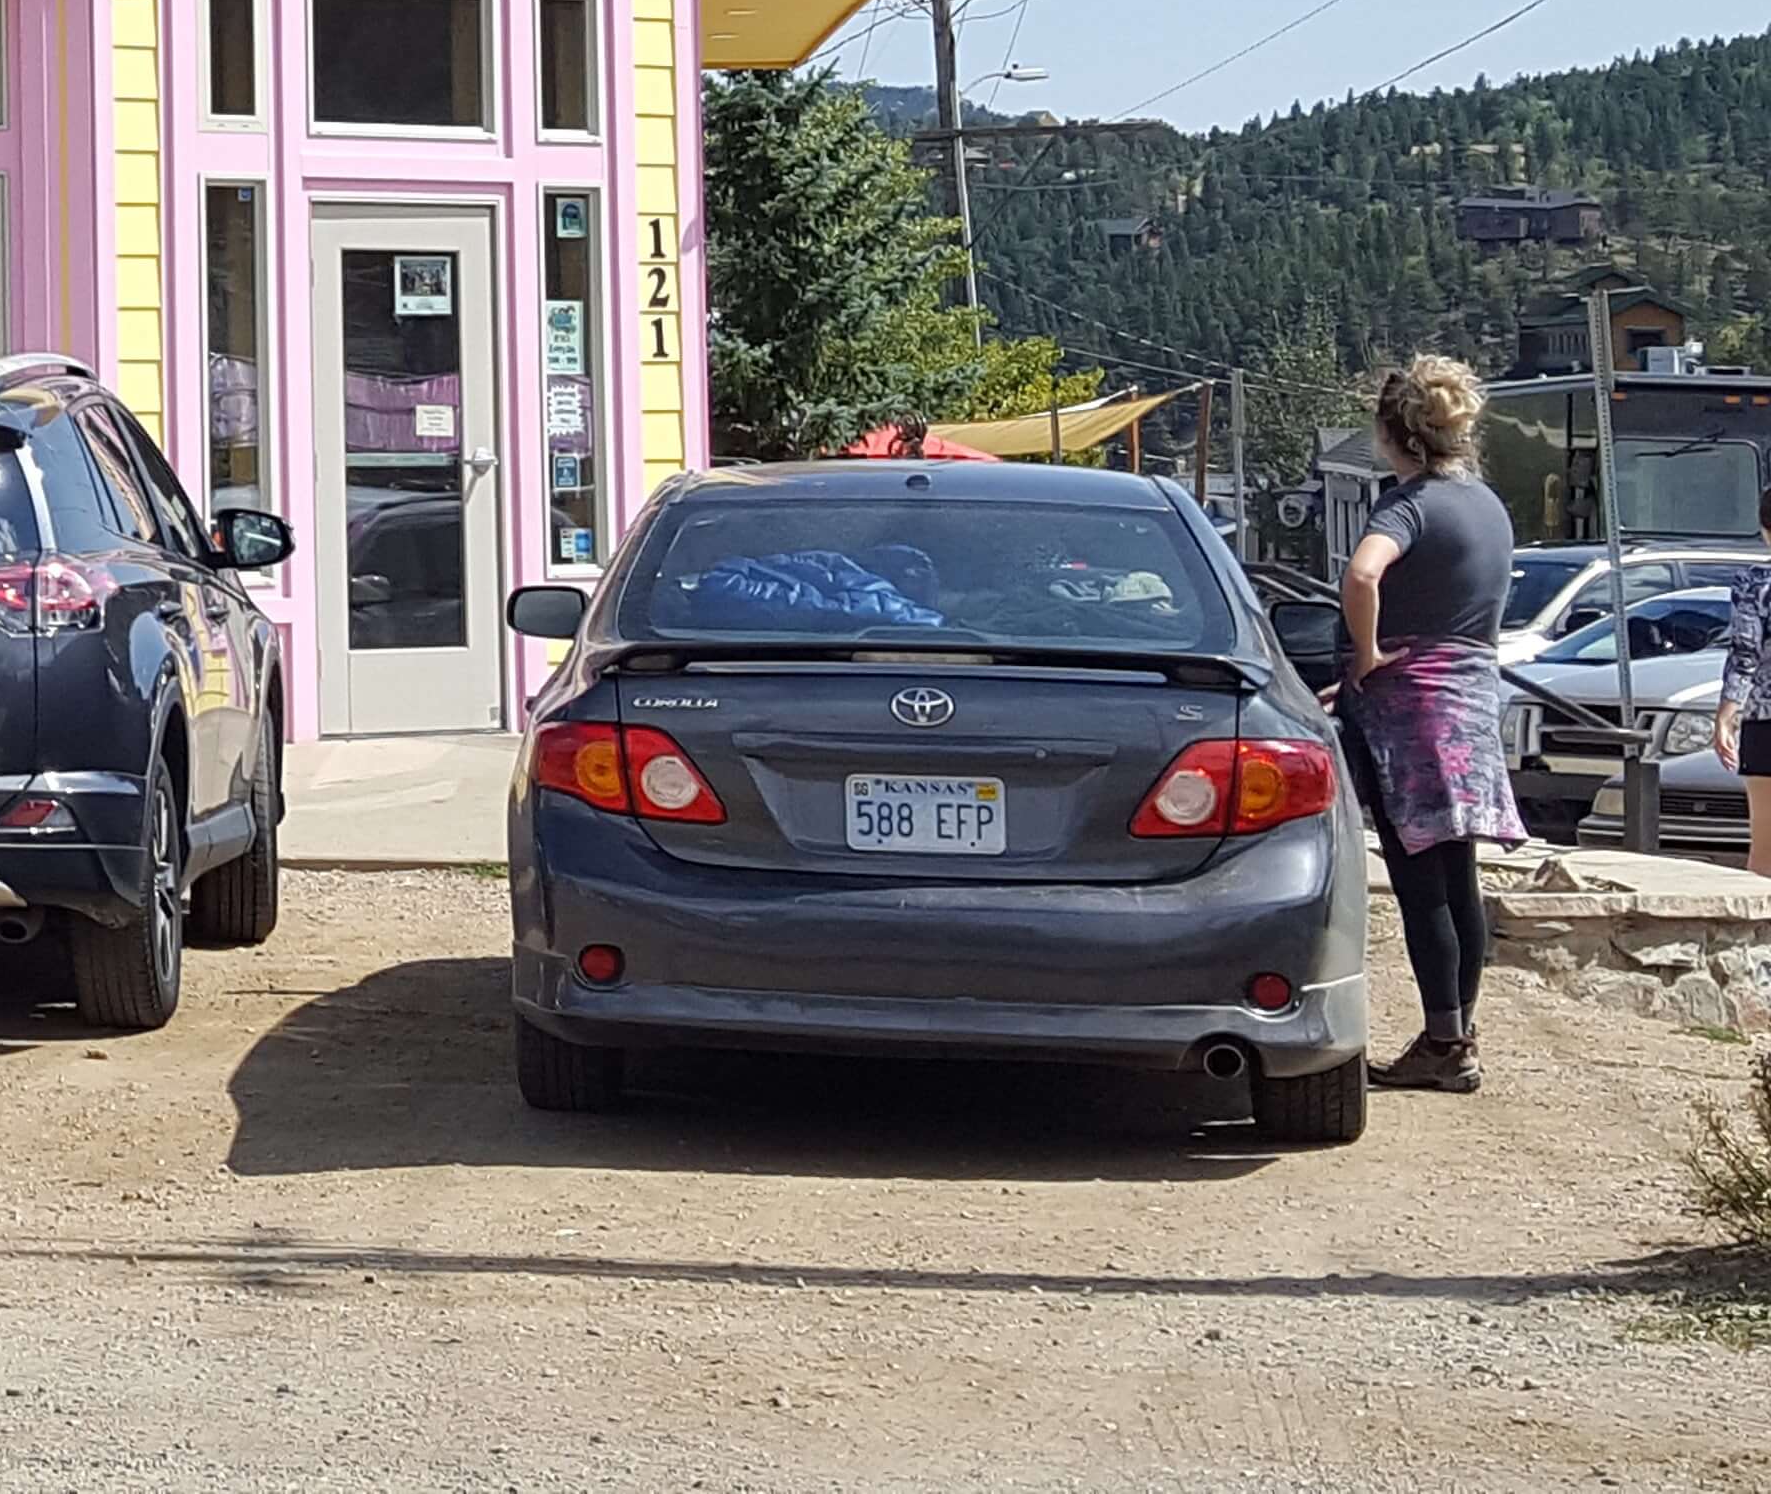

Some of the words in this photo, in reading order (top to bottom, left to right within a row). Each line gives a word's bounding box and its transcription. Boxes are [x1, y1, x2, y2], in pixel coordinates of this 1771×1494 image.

[884, 780, 968, 795] KANSAS
[856, 800, 914, 838] 588
[936, 803, 994, 840] EFP
